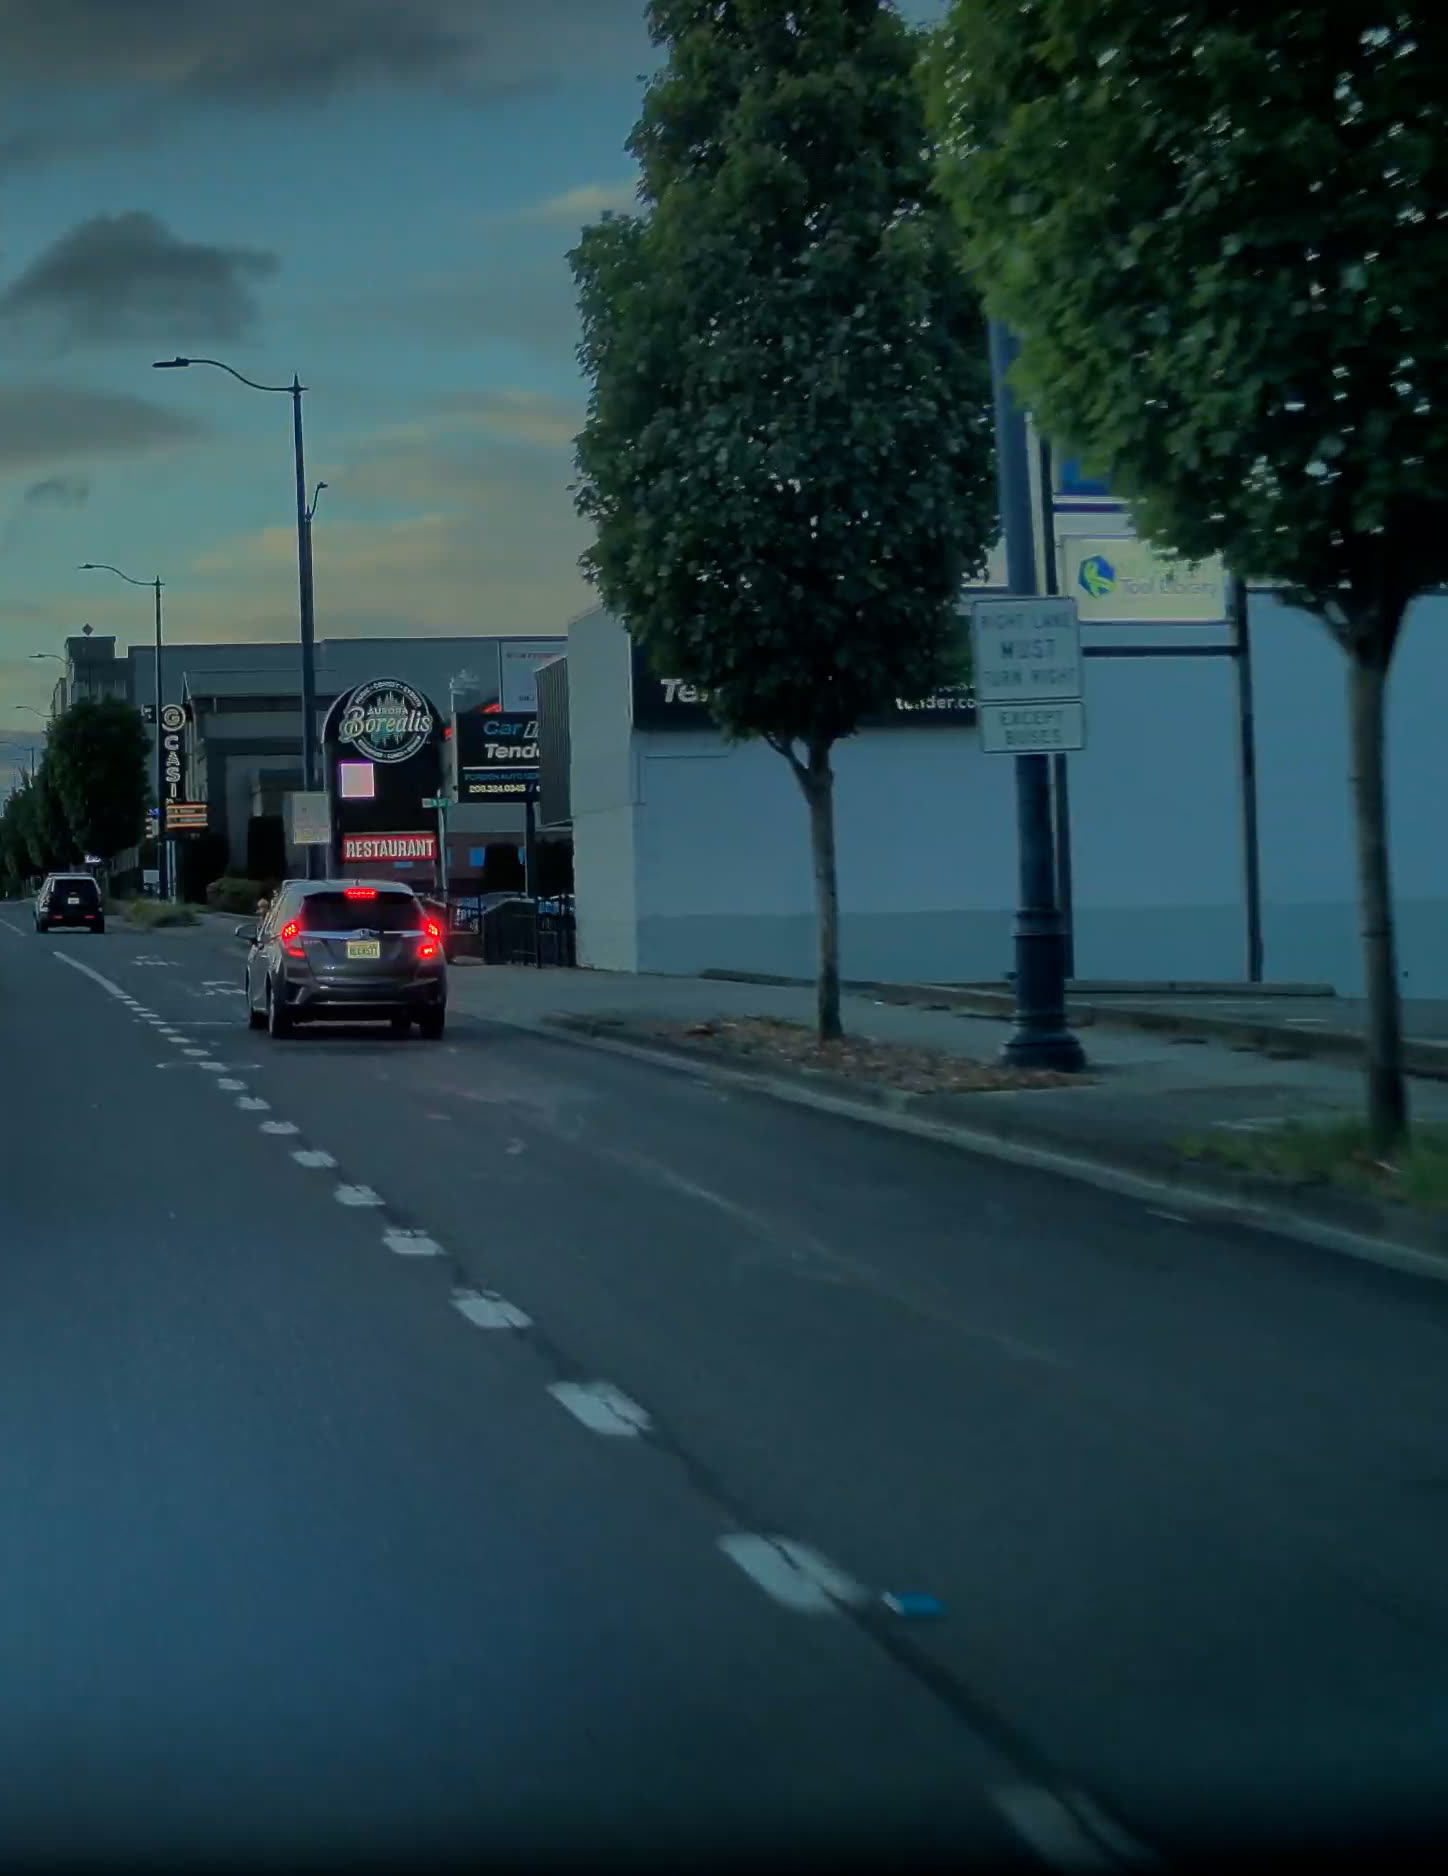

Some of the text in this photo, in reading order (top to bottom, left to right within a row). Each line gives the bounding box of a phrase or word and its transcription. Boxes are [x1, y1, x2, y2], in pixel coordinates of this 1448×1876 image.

[1000, 638, 1055, 659] MUST
[367, 704, 409, 715] AURORA
[1001, 710, 1062, 726] EXCEPT
[338, 705, 432, 743] Borealis
[483, 719, 522, 736] Car
[1005, 729, 1062, 745] BUSES
[345, 838, 434, 859] RESTAURANT
